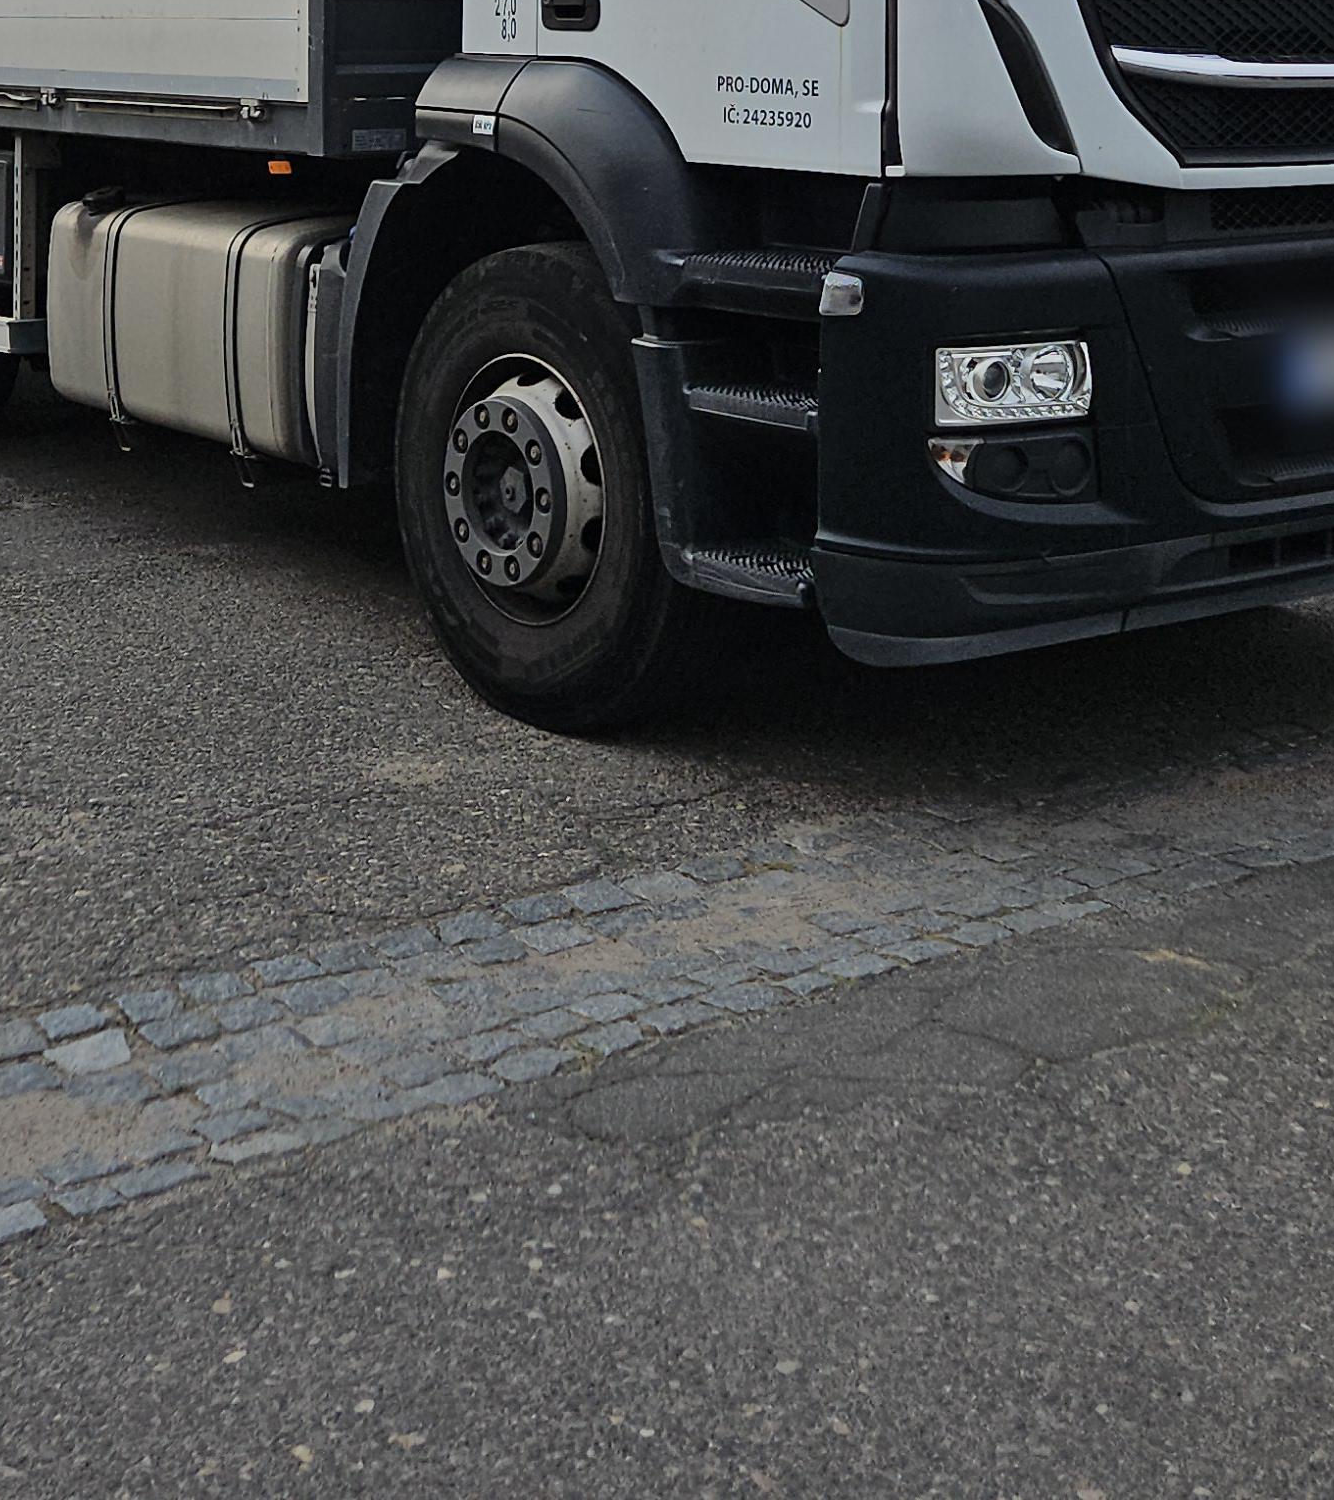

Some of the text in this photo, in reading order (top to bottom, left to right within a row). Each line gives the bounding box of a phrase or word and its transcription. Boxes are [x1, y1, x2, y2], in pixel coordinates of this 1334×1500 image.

[501, 18, 517, 42] 8,0
[717, 76, 819, 99] PRO-DOMA, SE
[723, 105, 812, 128] IČ: 24235920
